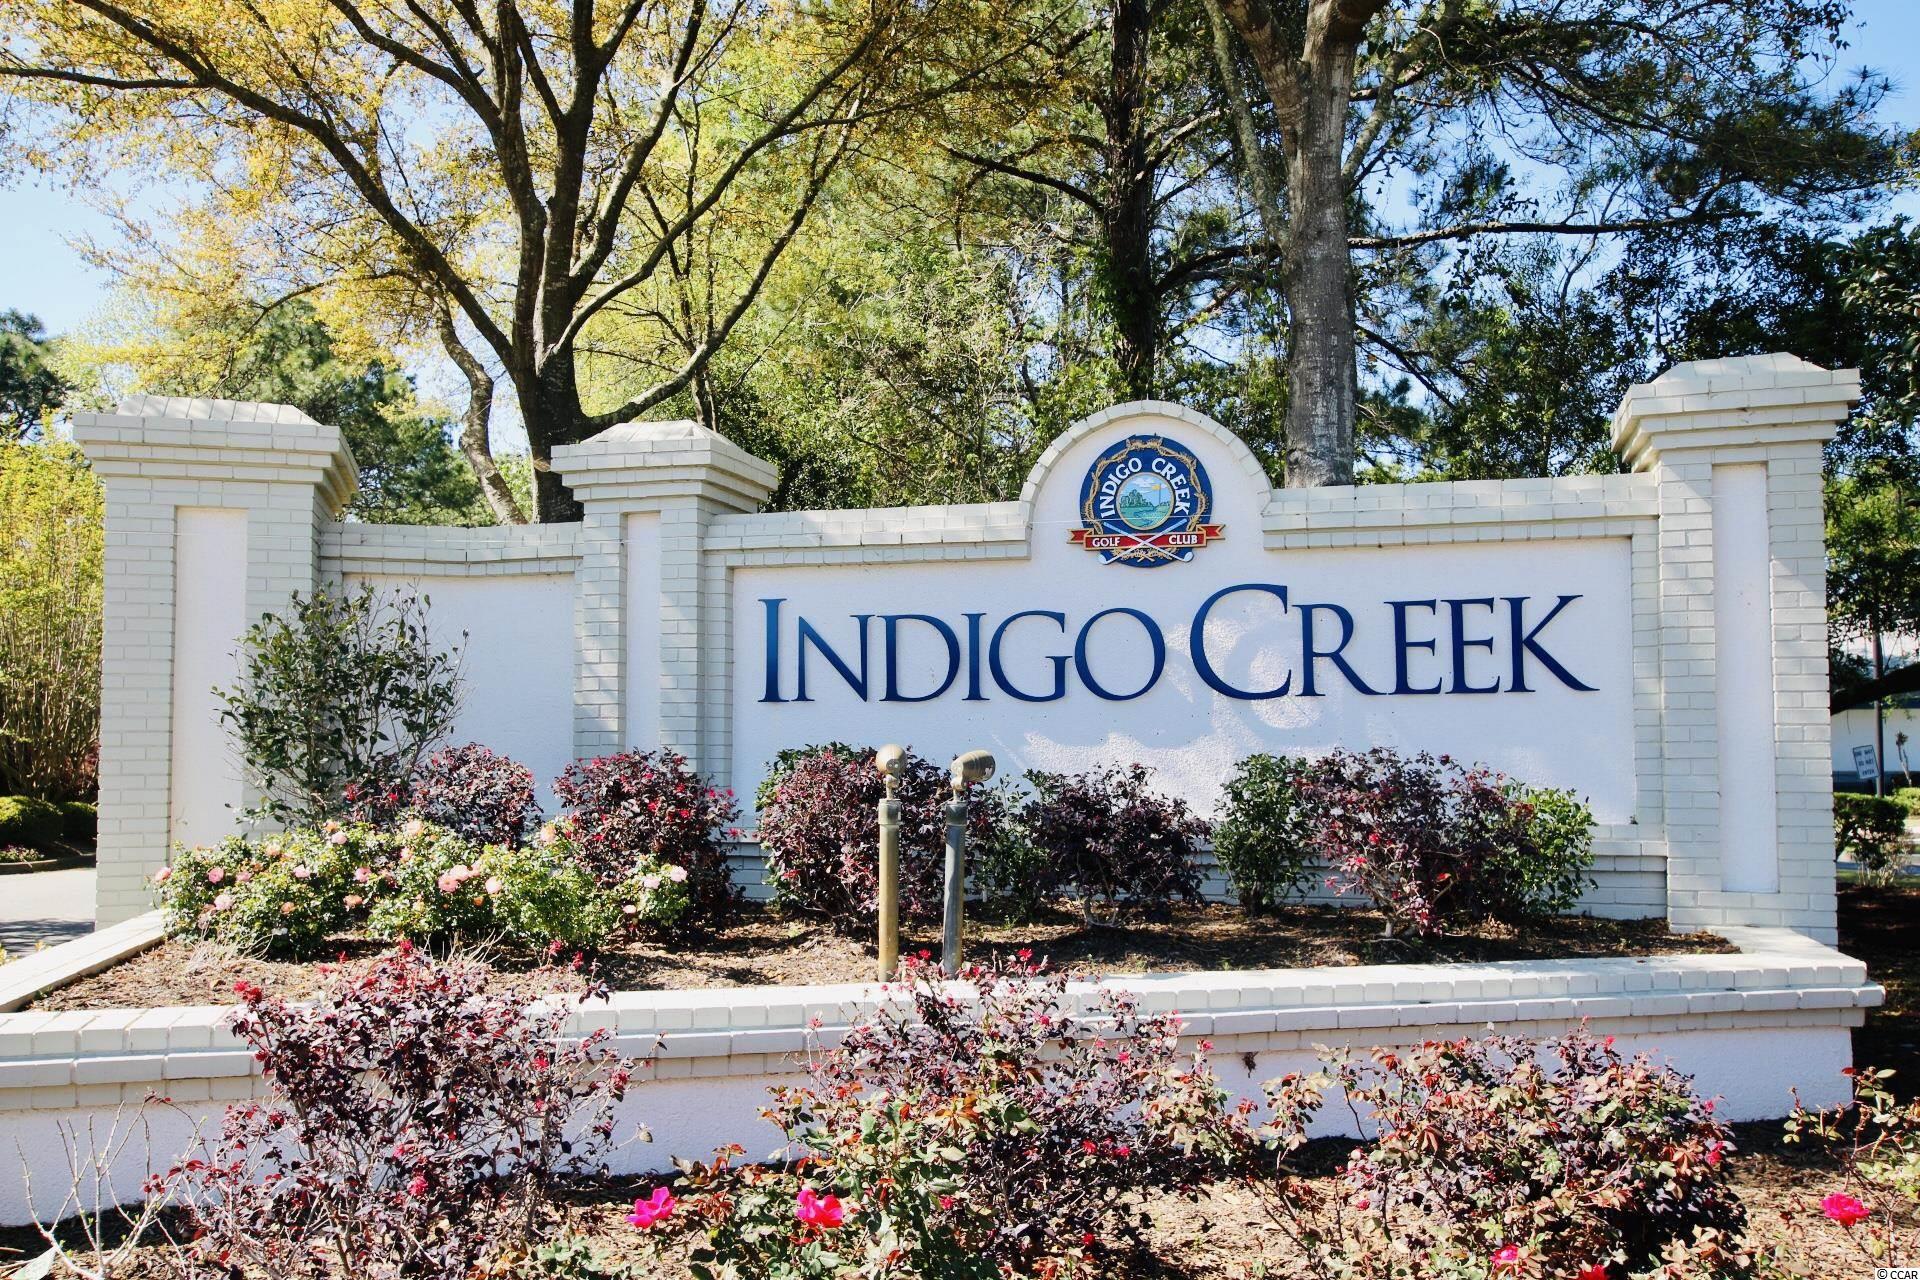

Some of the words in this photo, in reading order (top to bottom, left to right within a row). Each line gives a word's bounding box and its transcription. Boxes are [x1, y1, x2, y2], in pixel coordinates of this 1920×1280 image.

[1099, 457, 1143, 519] INDIGO
[1151, 457, 1191, 517] CREEK
[1092, 536, 1120, 547] GOLF
[1168, 533, 1198, 545] CLUB
[758, 598, 1166, 702] INDIGO
[1189, 583, 1601, 701] CREEK
